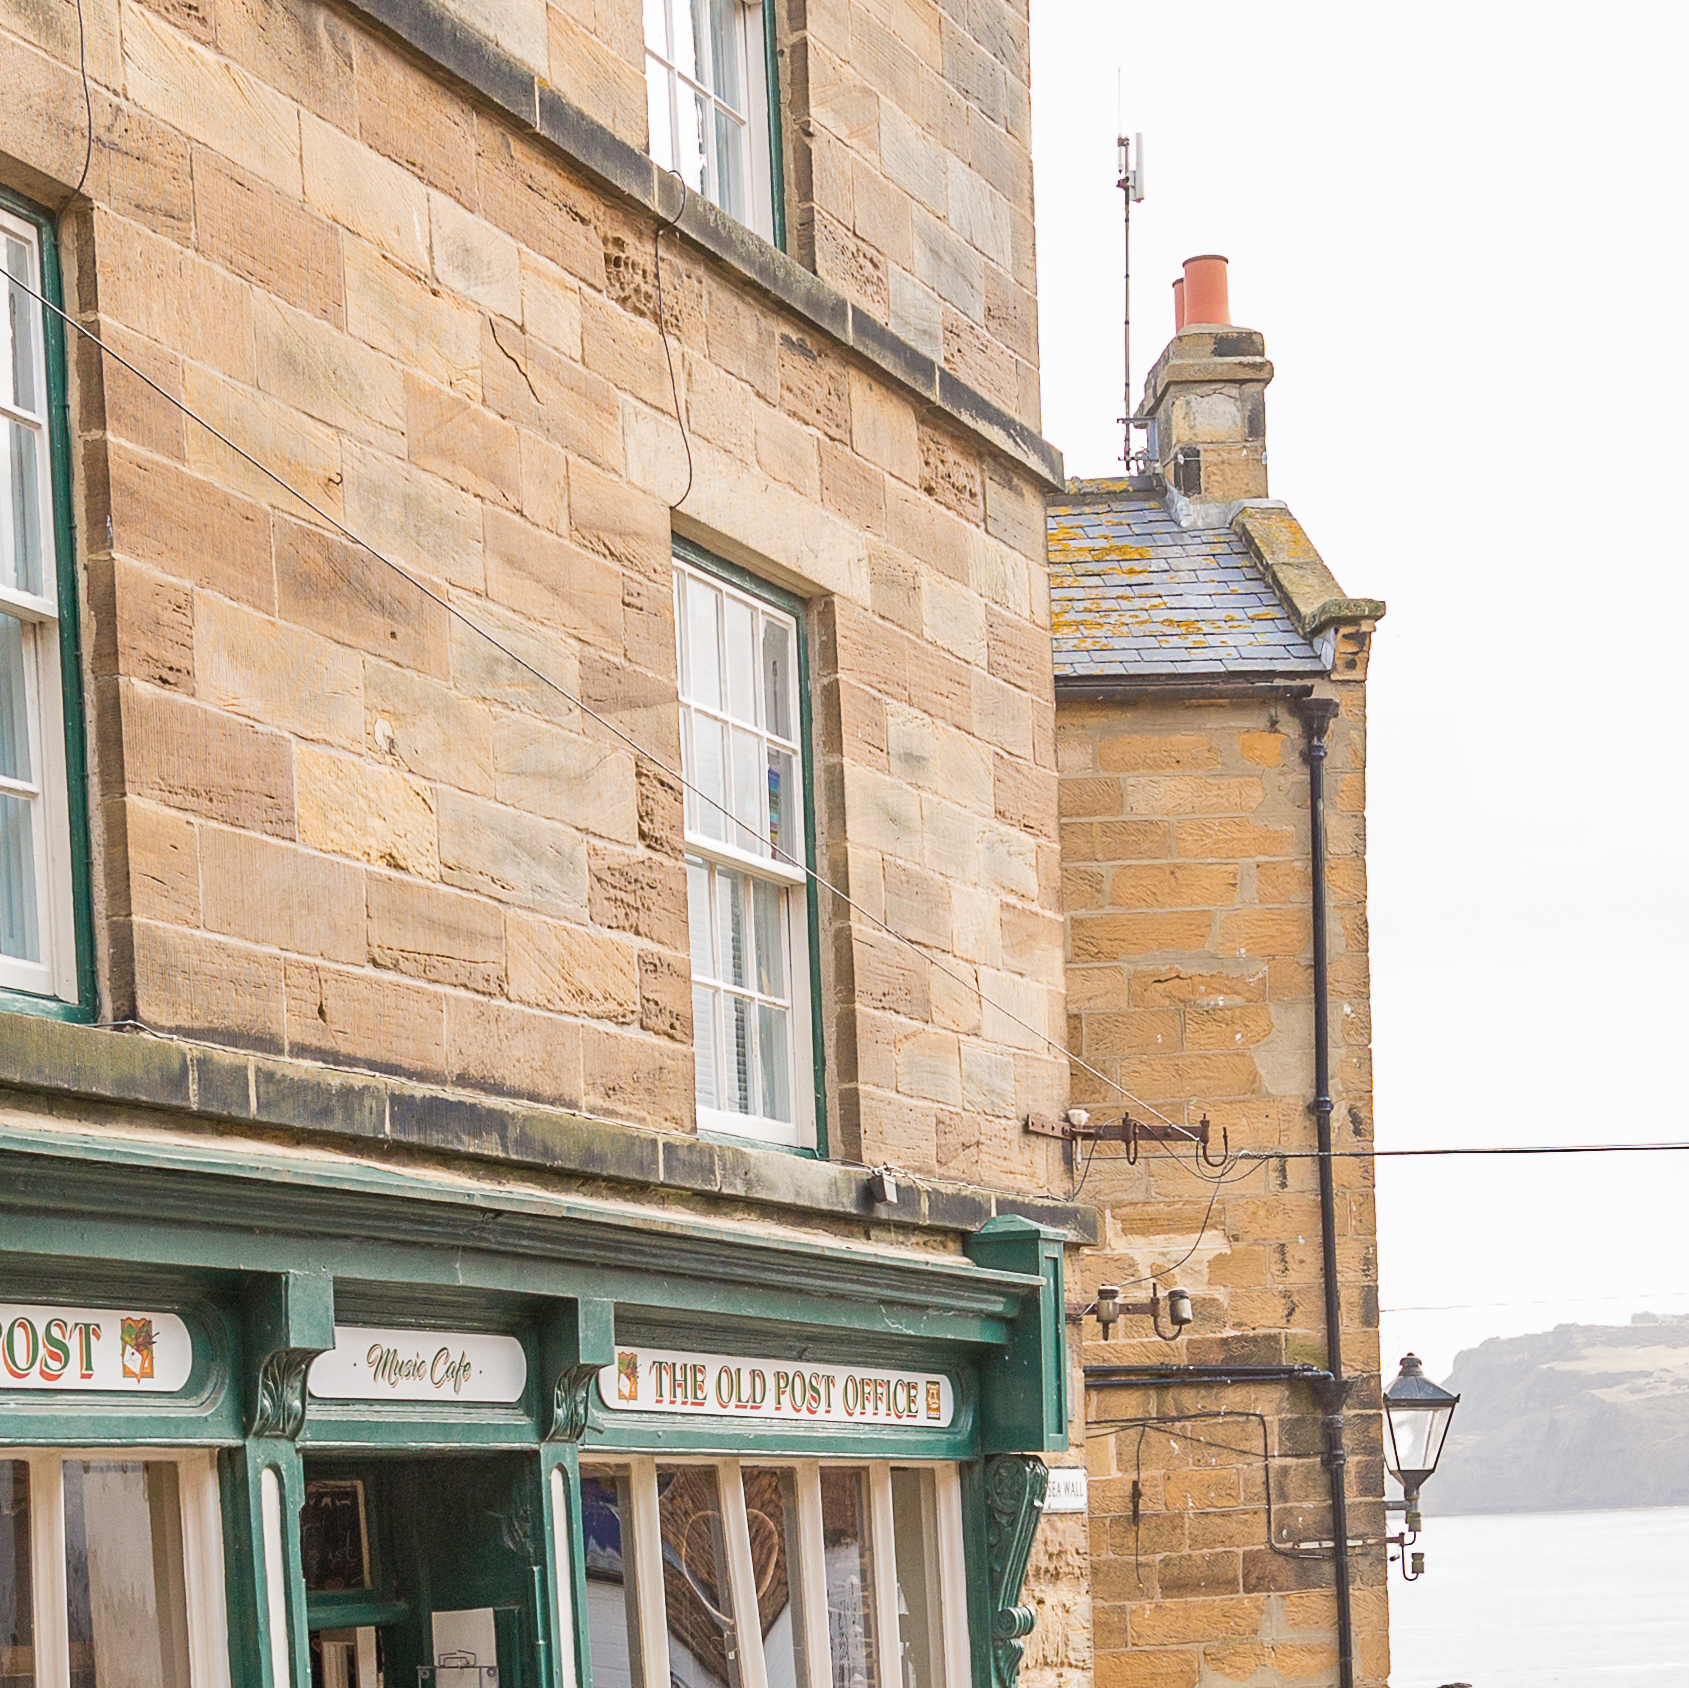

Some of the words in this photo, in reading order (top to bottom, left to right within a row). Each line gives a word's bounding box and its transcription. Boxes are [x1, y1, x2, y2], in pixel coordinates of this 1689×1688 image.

[366, 1343, 428, 1389] Music
[430, 1346, 472, 1396] Cafe
[648, 1360, 709, 1407] THE
[715, 1365, 767, 1410] OLD
[774, 1370, 836, 1415] POST
[842, 1374, 920, 1420] OFFICE
[1047, 1481, 1062, 1498] SEA
[1063, 1480, 1084, 1498] WALL
